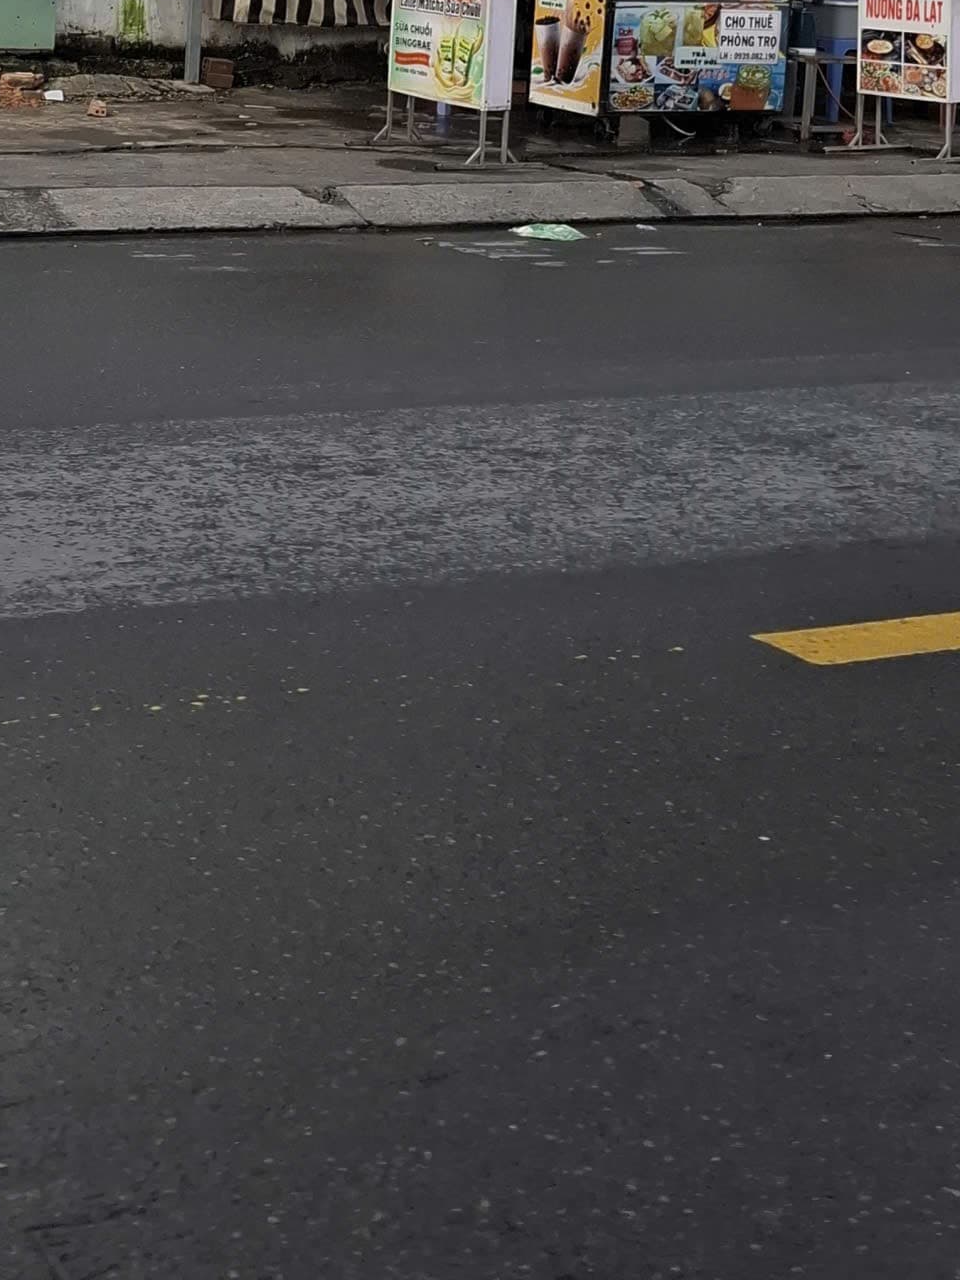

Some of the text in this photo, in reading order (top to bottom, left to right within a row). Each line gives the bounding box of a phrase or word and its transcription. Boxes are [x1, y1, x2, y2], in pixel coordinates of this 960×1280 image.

[725, 14, 773, 28] CHO THUÊ
[924, 0, 944, 28] LẠT
[720, 32, 777, 49] PHÒNG TRỌ
